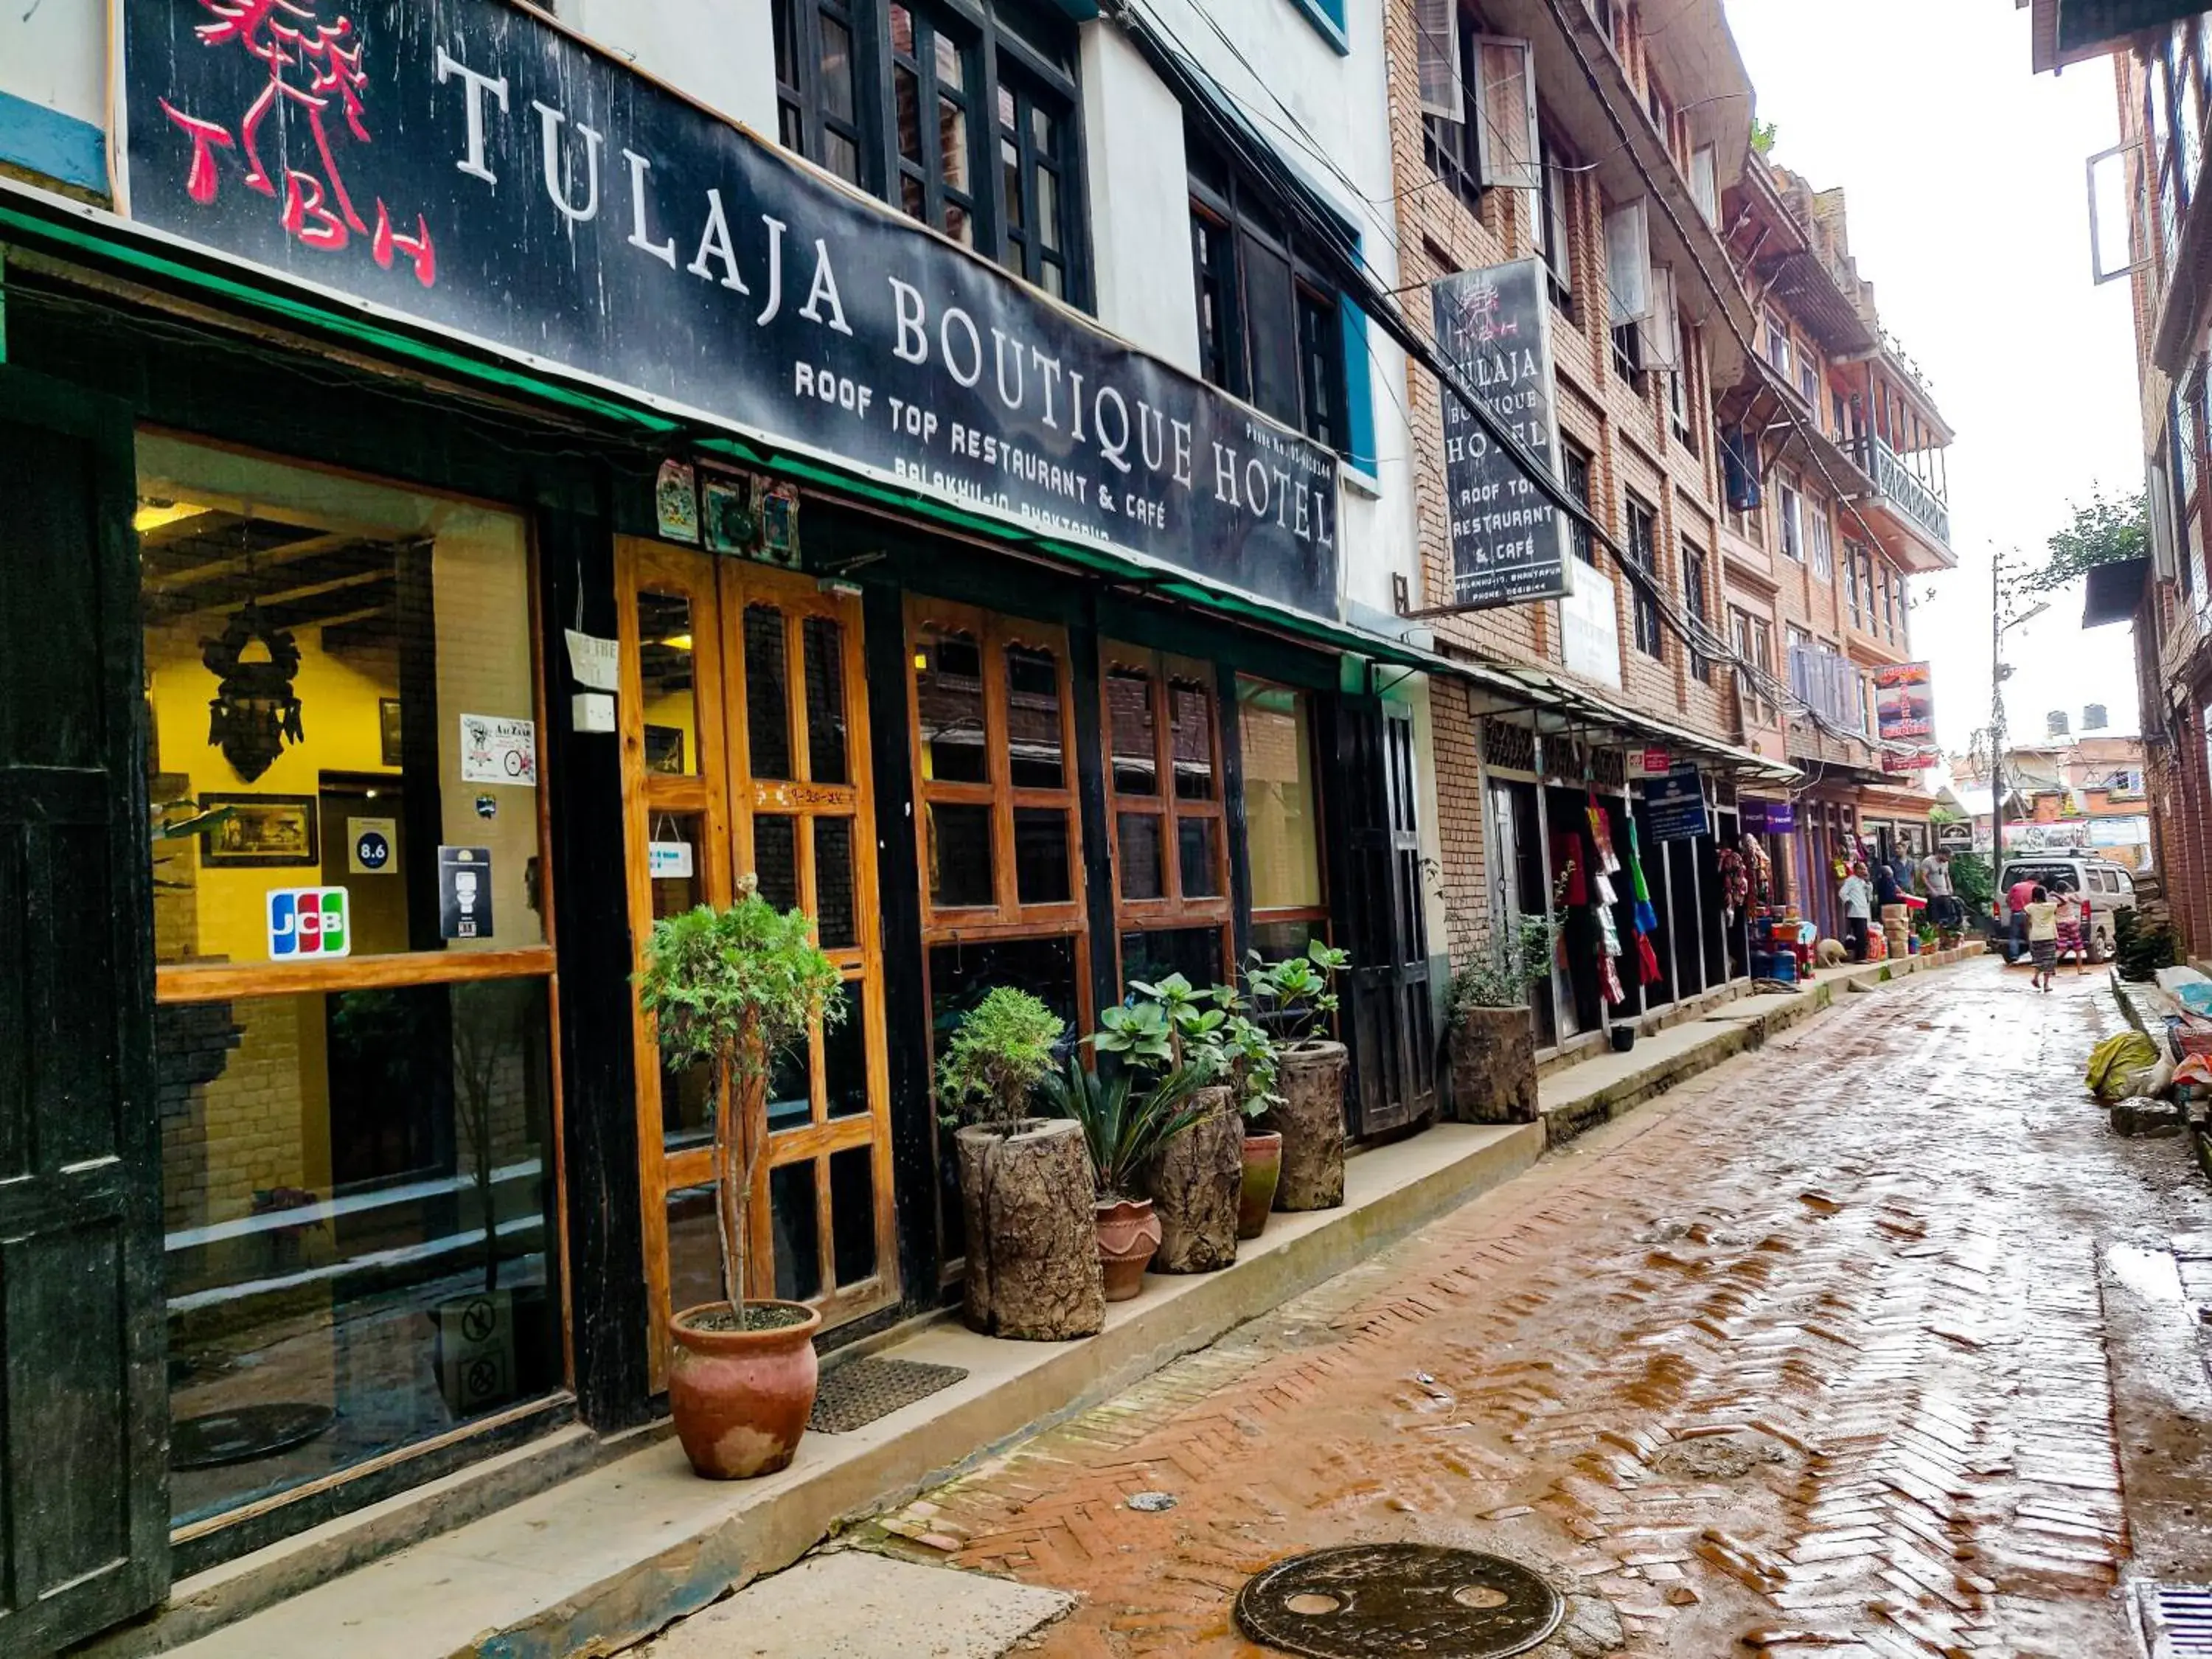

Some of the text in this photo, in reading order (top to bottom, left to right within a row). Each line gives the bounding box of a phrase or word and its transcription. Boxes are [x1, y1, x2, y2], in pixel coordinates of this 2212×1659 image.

[437, 45, 1333, 549] TULAJA BOUTIQUE HOTEL
[795, 361, 1166, 529] ROOF TOP RESTAURANT & CAFÉ
[1447, 421, 1547, 464] HOEL
[1461, 484, 1500, 507] ROOF
[1453, 505, 1554, 538] RESTAURANT
[1475, 532, 1534, 564] & CAFÉ
[361, 843, 386, 859] 8.6
